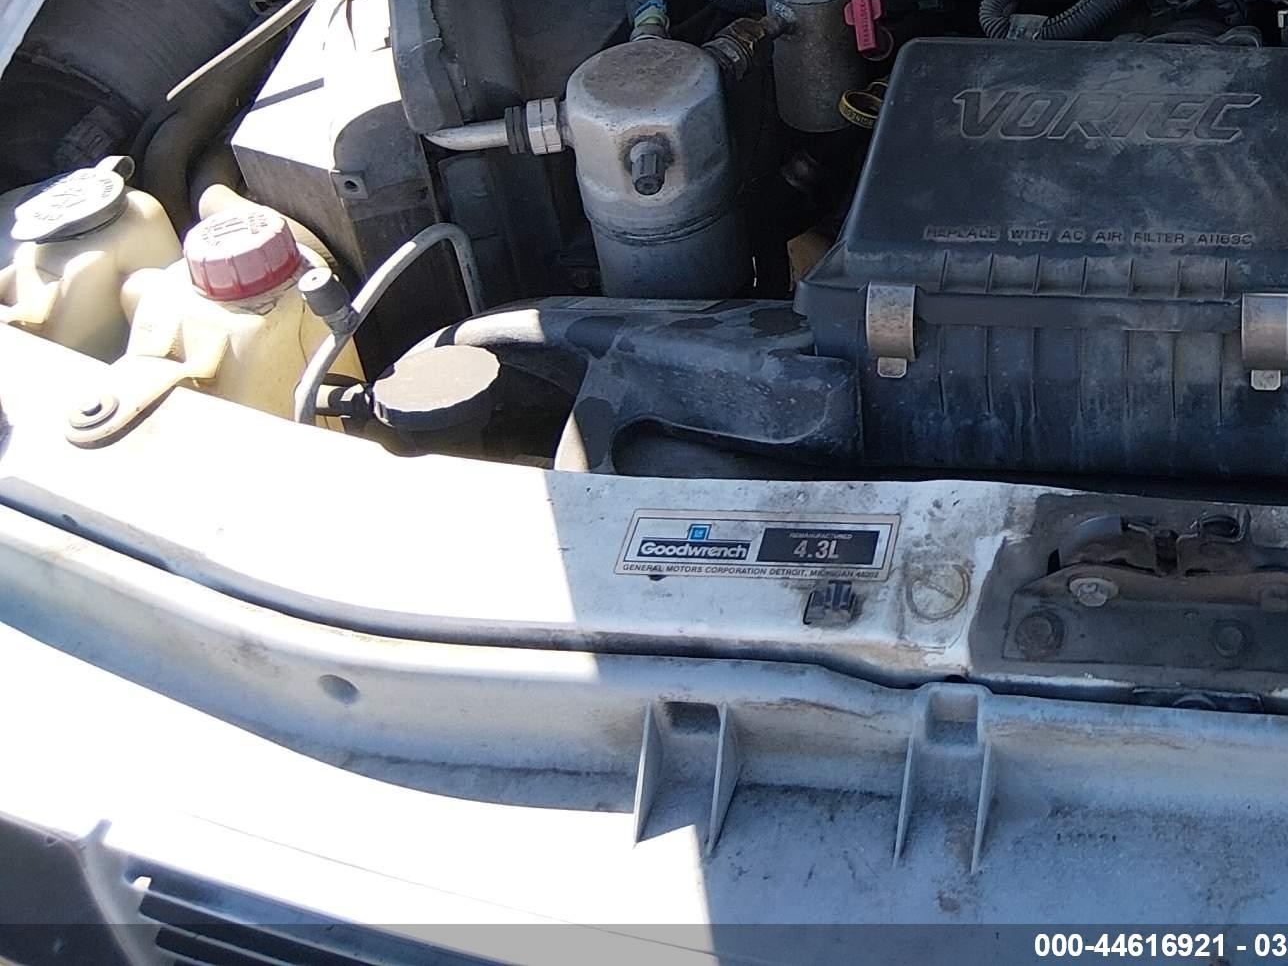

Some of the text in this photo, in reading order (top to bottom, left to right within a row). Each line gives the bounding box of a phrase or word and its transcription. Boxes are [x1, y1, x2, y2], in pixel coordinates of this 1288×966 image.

[952, 90, 1262, 142] VORTEC
[1010, 228, 1049, 240] WITH
[1061, 230, 1083, 242] AC
[1095, 231, 1122, 242] AIR
[1133, 232, 1185, 244] FILTER
[640, 542, 747, 559] Goodwrench
[793, 539, 839, 559] 4.3L
[622, 563, 662, 572] GENERAL
[666, 564, 703, 573] MOTORS
[706, 566, 767, 576] CORPORATION
[769, 568, 808, 577] DETROIT,
